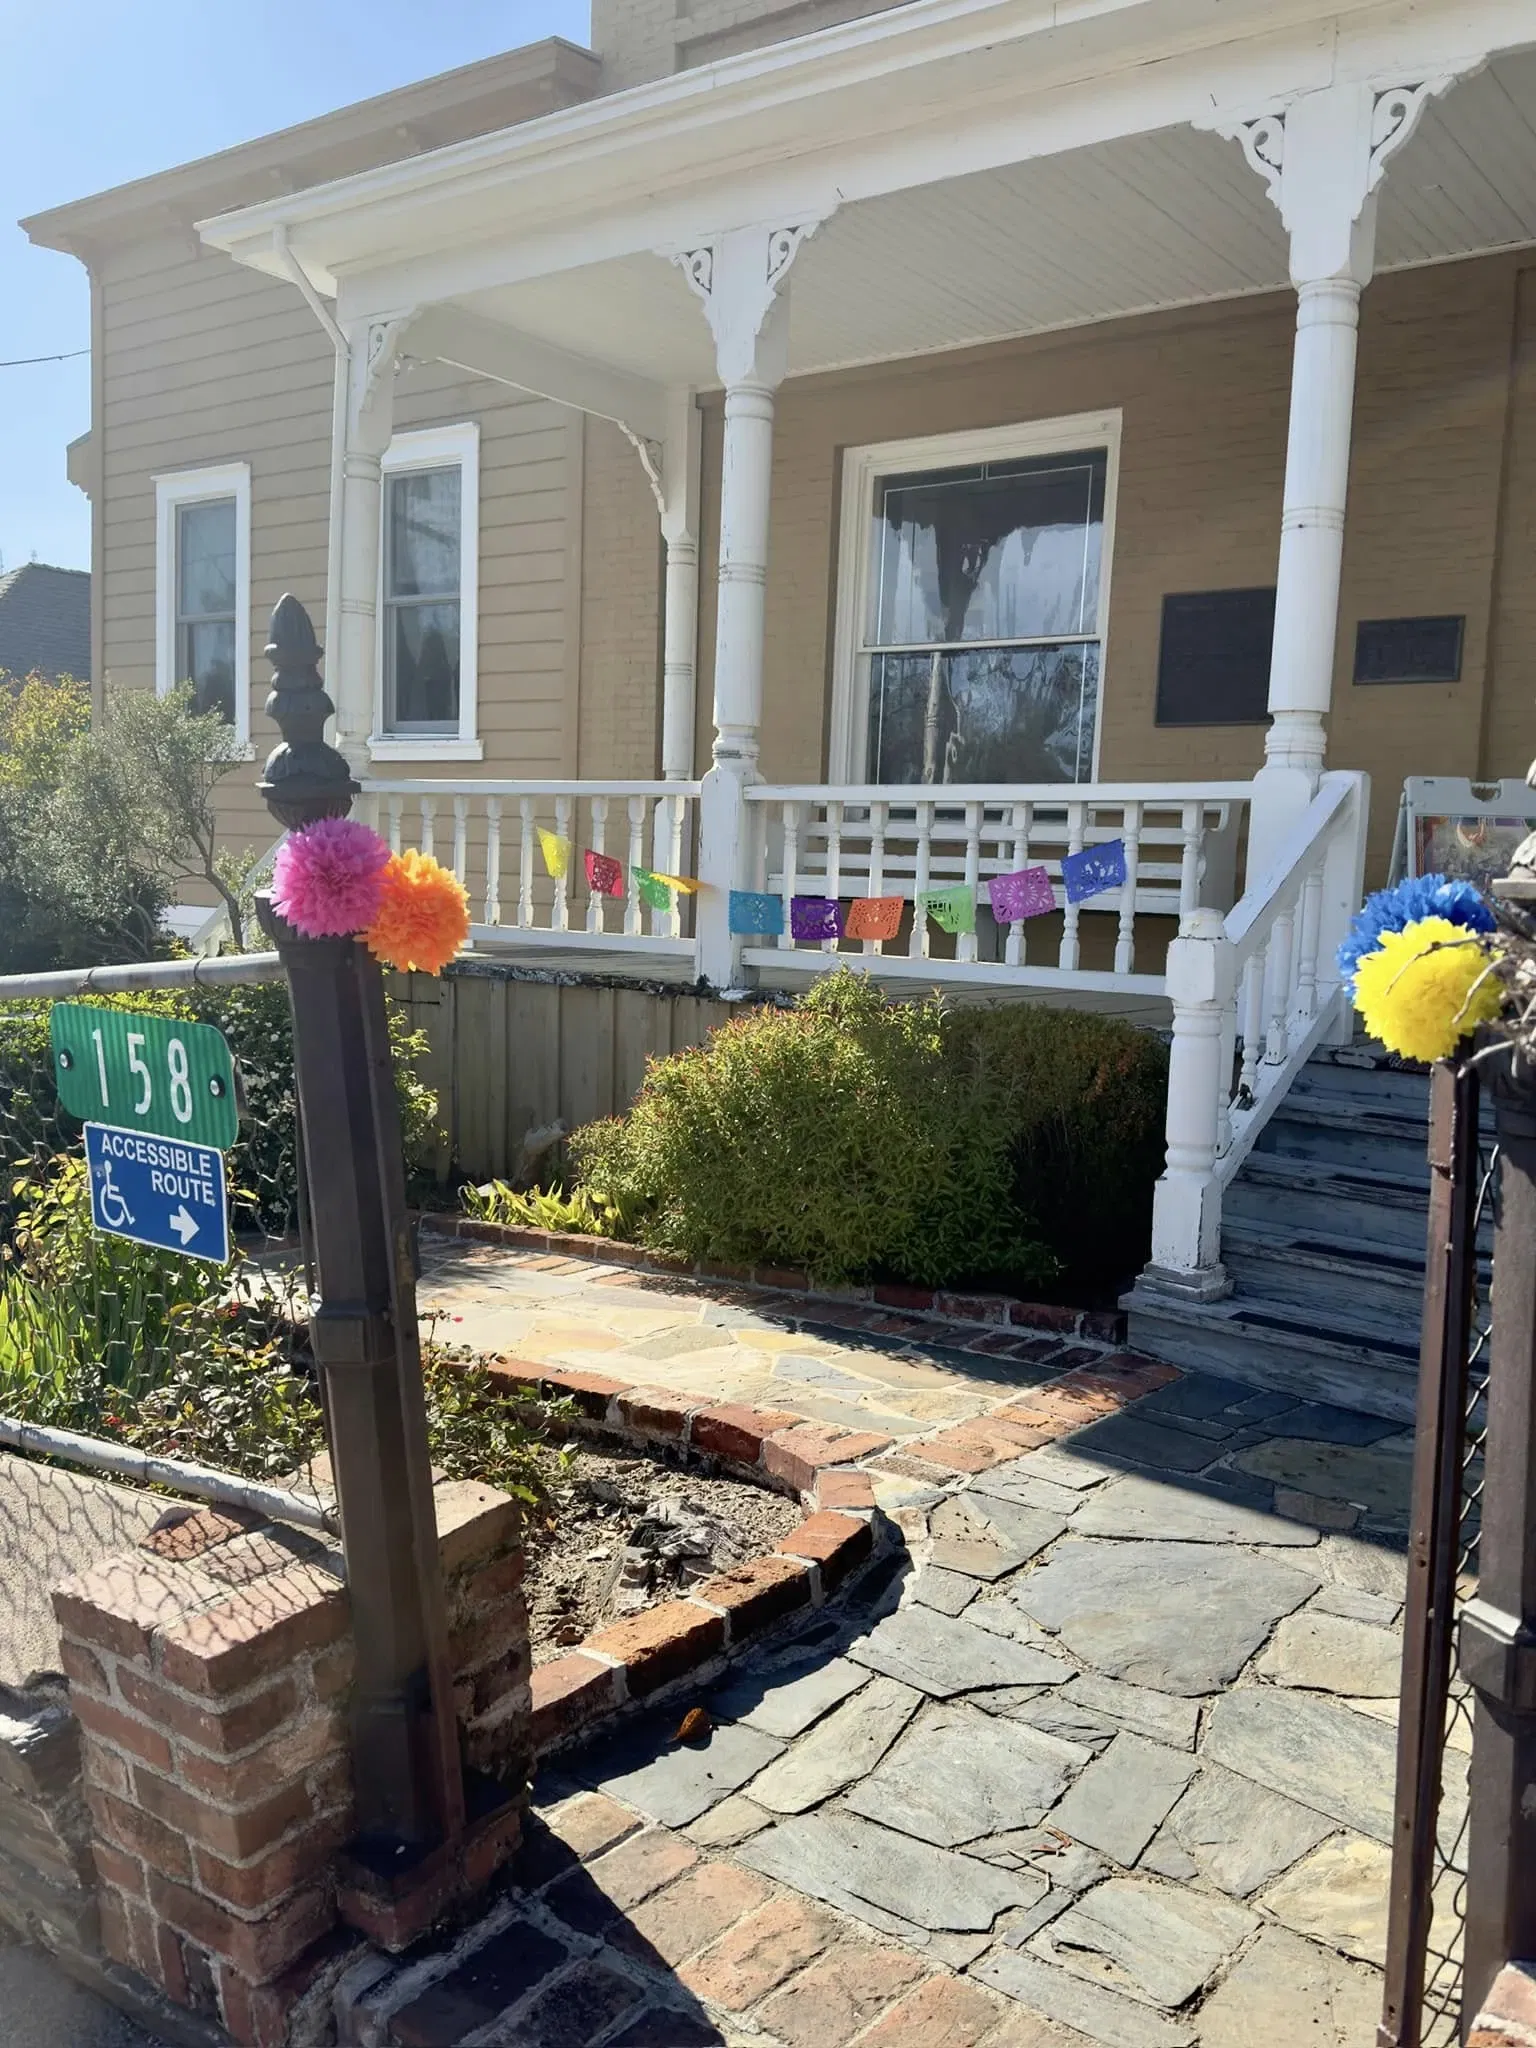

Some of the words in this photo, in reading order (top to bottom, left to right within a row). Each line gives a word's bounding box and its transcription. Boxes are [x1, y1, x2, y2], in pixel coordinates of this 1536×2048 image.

[92, 1028, 193, 1123] 158
[102, 1133, 212, 1177] ACCESSIBLE
[151, 1170, 216, 1207] ROUTE
